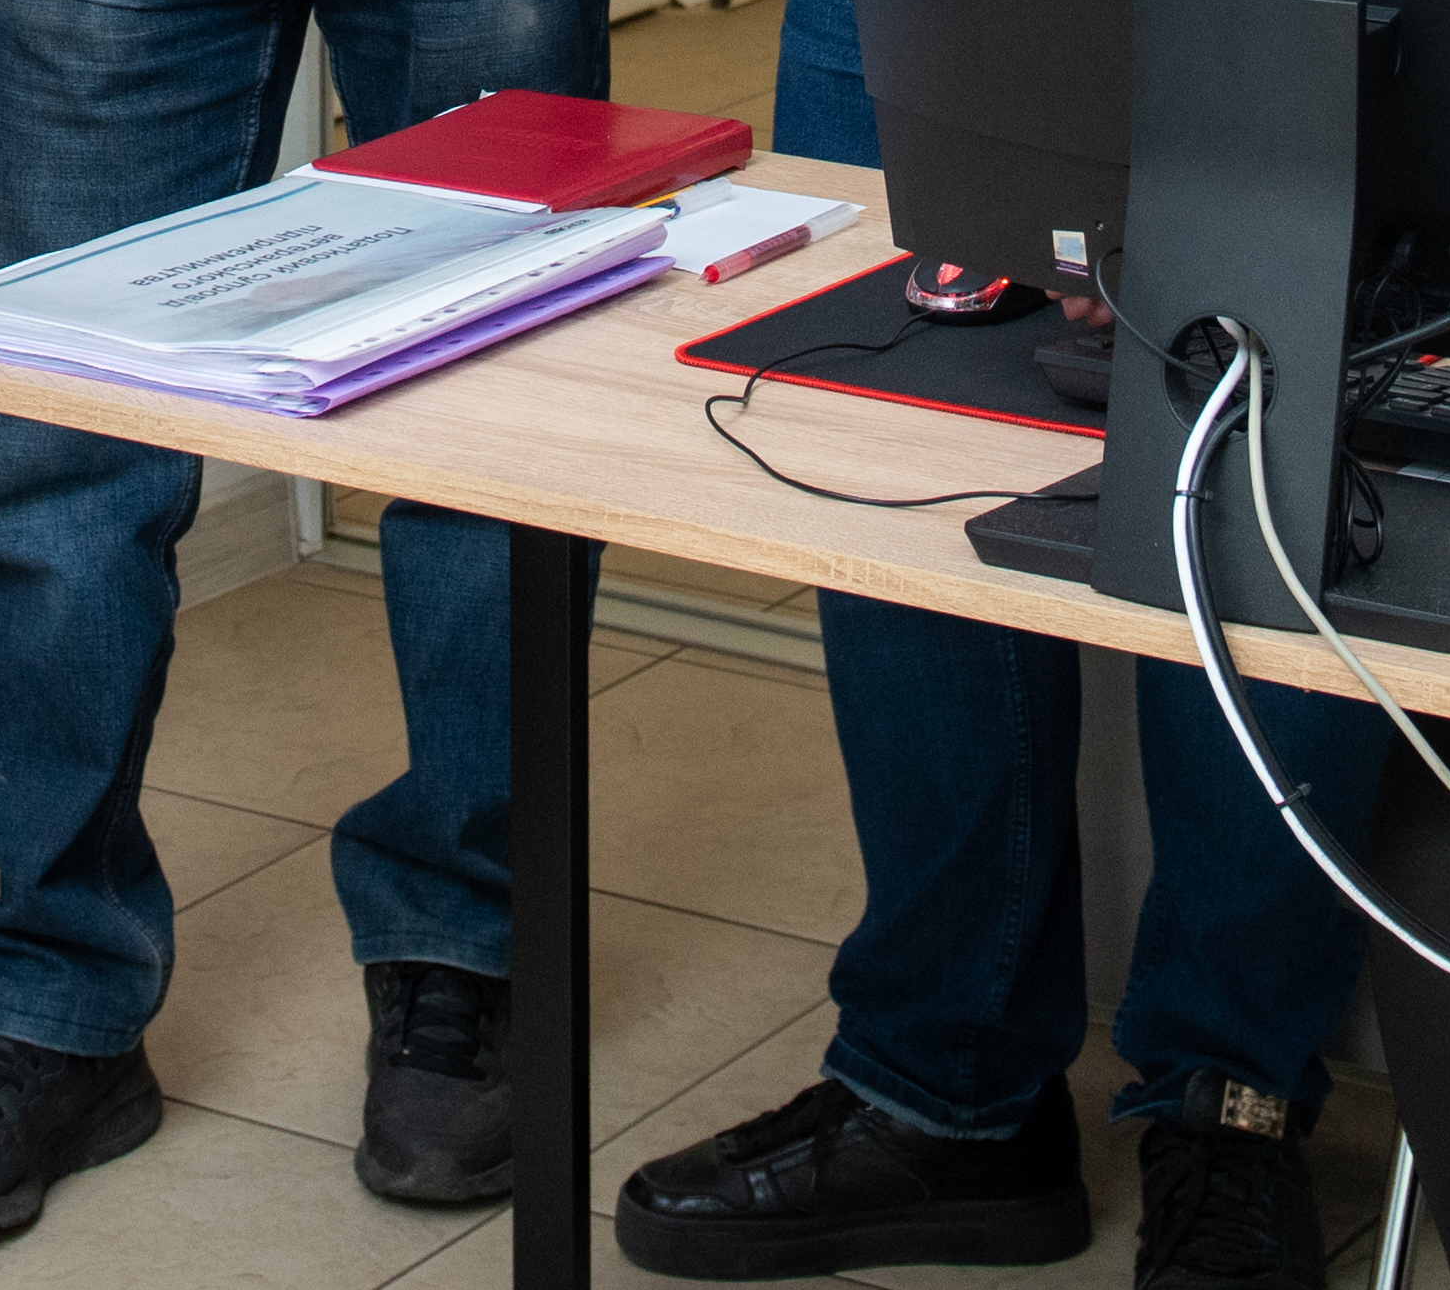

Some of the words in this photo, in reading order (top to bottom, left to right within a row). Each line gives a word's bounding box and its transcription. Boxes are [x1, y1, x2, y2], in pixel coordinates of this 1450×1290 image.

[128, 224, 324, 287] підприємництва
[171, 232, 345, 290] ветеранського
[271, 226, 414, 275] Податковий
[158, 273, 273, 308] супровід
